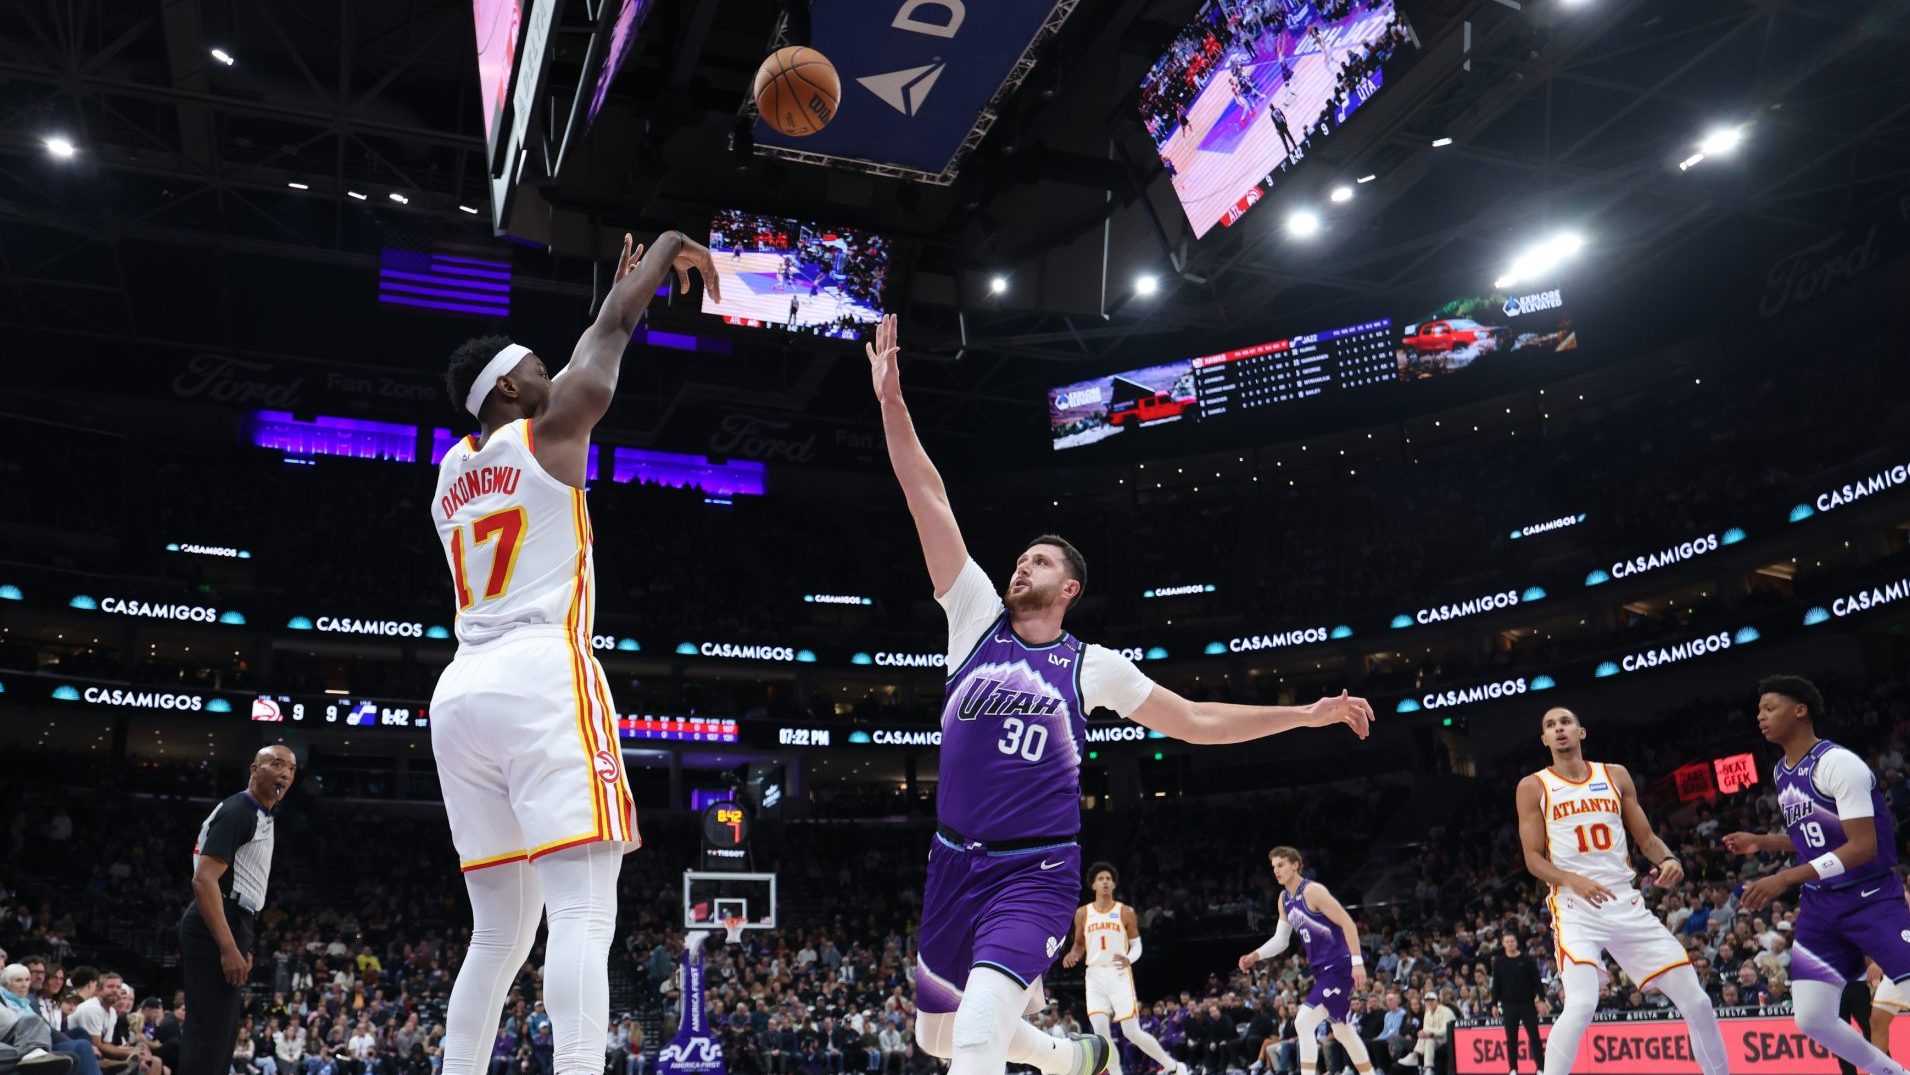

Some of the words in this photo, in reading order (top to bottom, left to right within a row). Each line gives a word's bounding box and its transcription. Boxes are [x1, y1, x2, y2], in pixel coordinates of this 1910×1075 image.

[171, 353, 304, 407] Ford
[327, 372, 372, 393] Fan
[378, 377, 439, 400] Zone
[709, 404, 817, 463] Ford
[441, 466, 521, 520] OKONGWU
[1816, 463, 1910, 512] CASAMIG
[1522, 515, 1576, 536] CASAMIGOS
[180, 543, 237, 558] CASAMIGOS
[450, 504, 529, 613] 17
[1612, 533, 1719, 579] CASAMIGOS
[814, 594, 861, 605] CASAMIGOS
[1155, 584, 1204, 597] CASAMIGOS
[1832, 578, 1910, 617] CASAMI
[101, 597, 217, 623] CASAMIGOS
[1416, 589, 1519, 624] CASAMIGOS
[316, 616, 423, 638] CASAMIGOS
[1229, 627, 1328, 653] CASAMIGOS
[701, 642, 794, 662] CASAMIGOS
[874, 652, 948, 667] CASAMIG
[1047, 652, 1071, 669] LVT
[1622, 631, 1731, 672] CASAMIGOS
[84, 687, 202, 711] CASAMIGOS
[957, 676, 1065, 721] UTAH
[1423, 678, 1527, 709] CASAMIGOS
[292, 703, 304, 720] 9
[326, 705, 338, 722] 9
[381, 708, 410, 726] 8:42
[779, 728, 810, 746] 07:22
[811, 729, 830, 746] PM
[873, 730, 942, 745] CASAMIG
[997, 717, 1049, 762] 30
[1085, 727, 1145, 742] AMIGOS
[1722, 760, 1748, 776] SEAT
[1724, 772, 1751, 788] GEEK
[1553, 798, 1620, 821] ATLANTA
[1574, 823, 1612, 854] 10
[1800, 821, 1826, 848] 19
[1088, 921, 1121, 934] ATLANTA
[1100, 935, 1107, 951] 1
[691, 967, 700, 991] FIRST
[691, 992, 700, 1032] AMERICA
[1460, 1019, 1478, 1027] DELTA
[1594, 1013, 1617, 1021] DELTA
[1633, 1011, 1658, 1020] DELTA
[1720, 1008, 1747, 1017] DELTA
[1743, 1031, 1830, 1063] SEATG
[670, 1062, 700, 1070] AMERICA
[701, 1061, 721, 1069] FIRST
